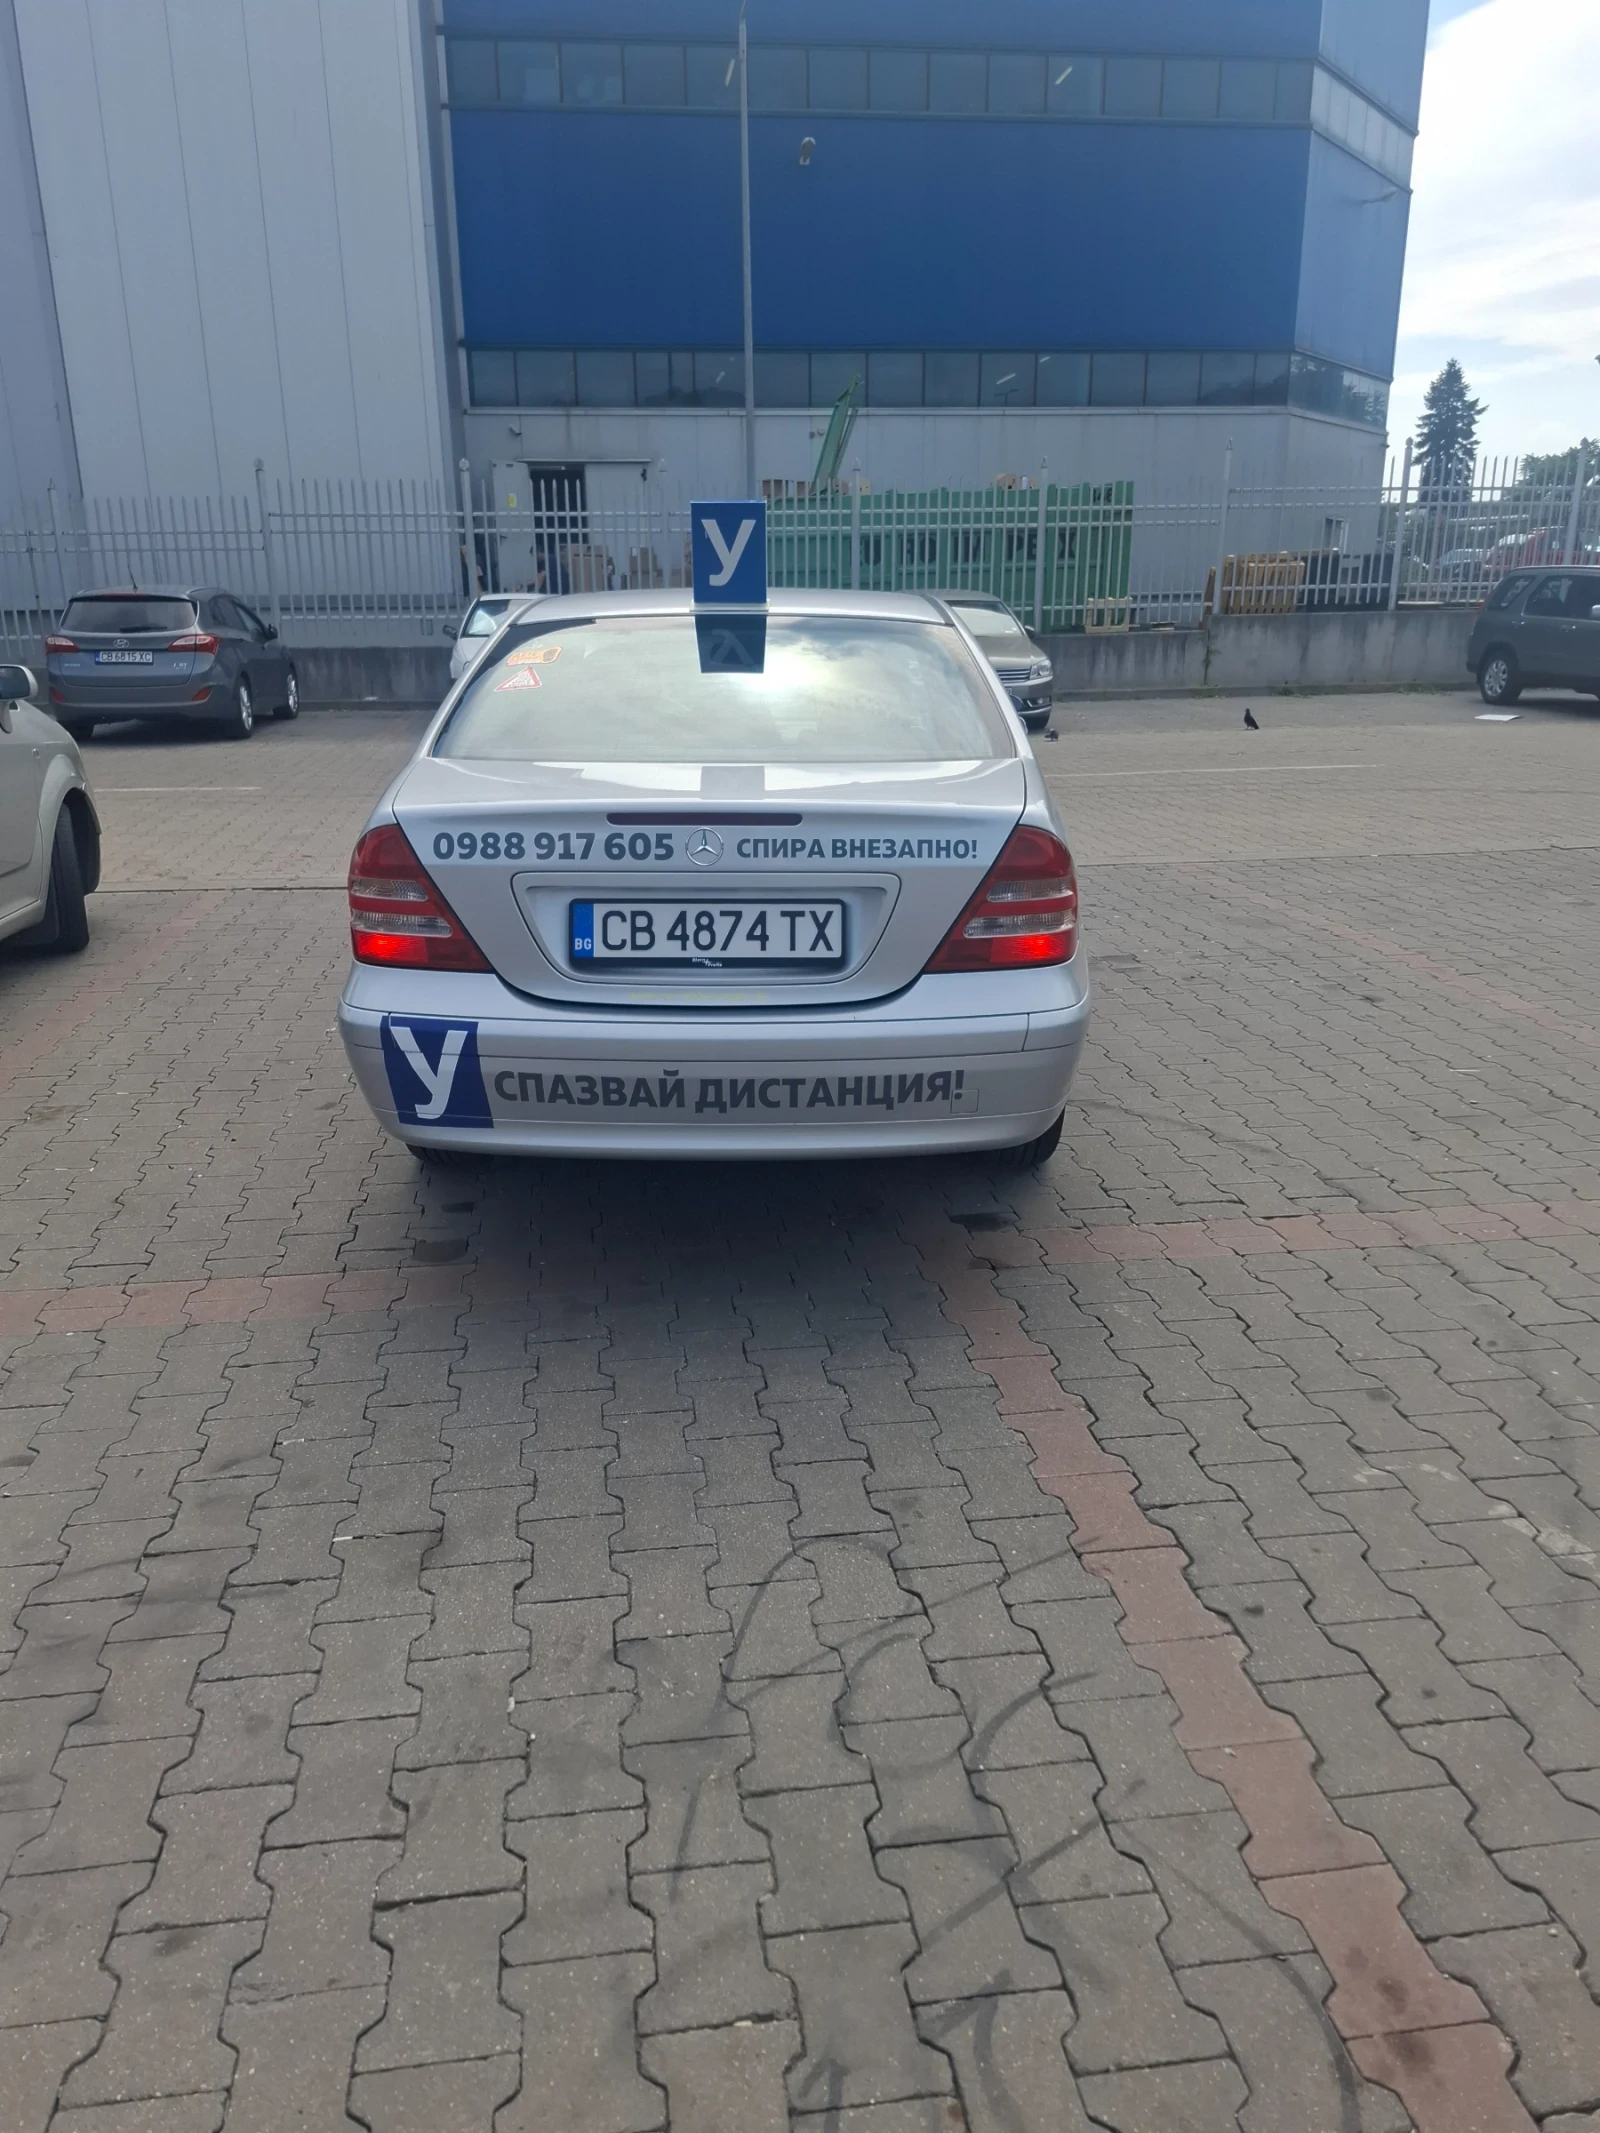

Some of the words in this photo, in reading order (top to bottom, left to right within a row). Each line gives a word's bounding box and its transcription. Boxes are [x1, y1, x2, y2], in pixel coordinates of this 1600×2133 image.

[701, 519, 757, 587] У
[433, 832, 525, 860] 0988
[534, 832, 596, 861] 917
[604, 832, 675, 861] 605
[736, 837, 826, 859] СПИРА
[831, 838, 978, 860] ВНЕЗАПНО!
[574, 938, 592, 950] BG
[666, 910, 769, 951] 4874
[389, 1026, 468, 1120] У
[493, 1068, 686, 1109] СПАЗВАЙ
[695, 1069, 965, 1114] ДИСТАНЦИЯ!
